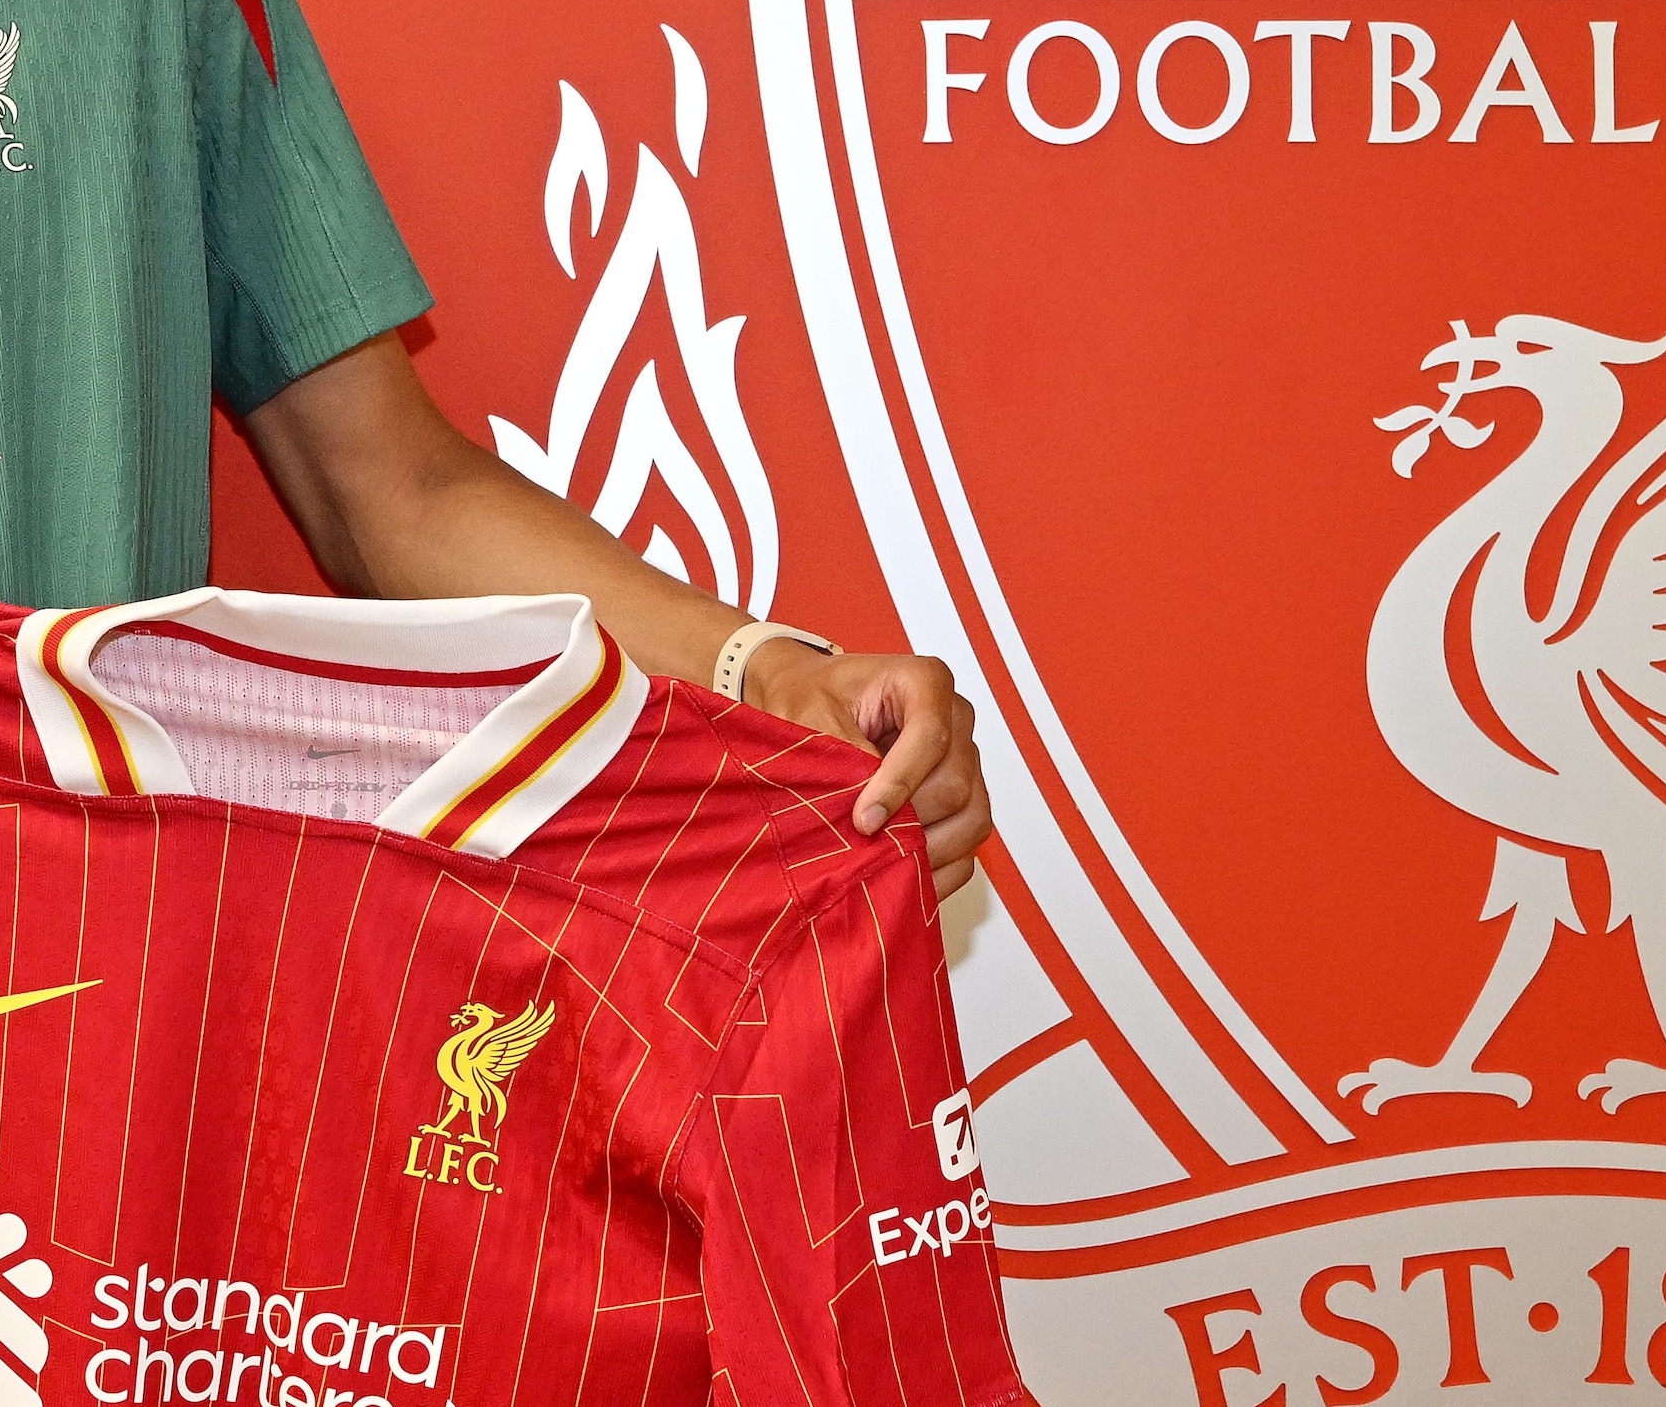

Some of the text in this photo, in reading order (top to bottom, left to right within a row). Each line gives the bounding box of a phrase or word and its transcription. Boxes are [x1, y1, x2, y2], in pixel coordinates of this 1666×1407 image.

[402, 1135, 505, 1195] L.F.C.
[89, 1263, 446, 1389] standard
[84, 1336, 455, 1407] charte
